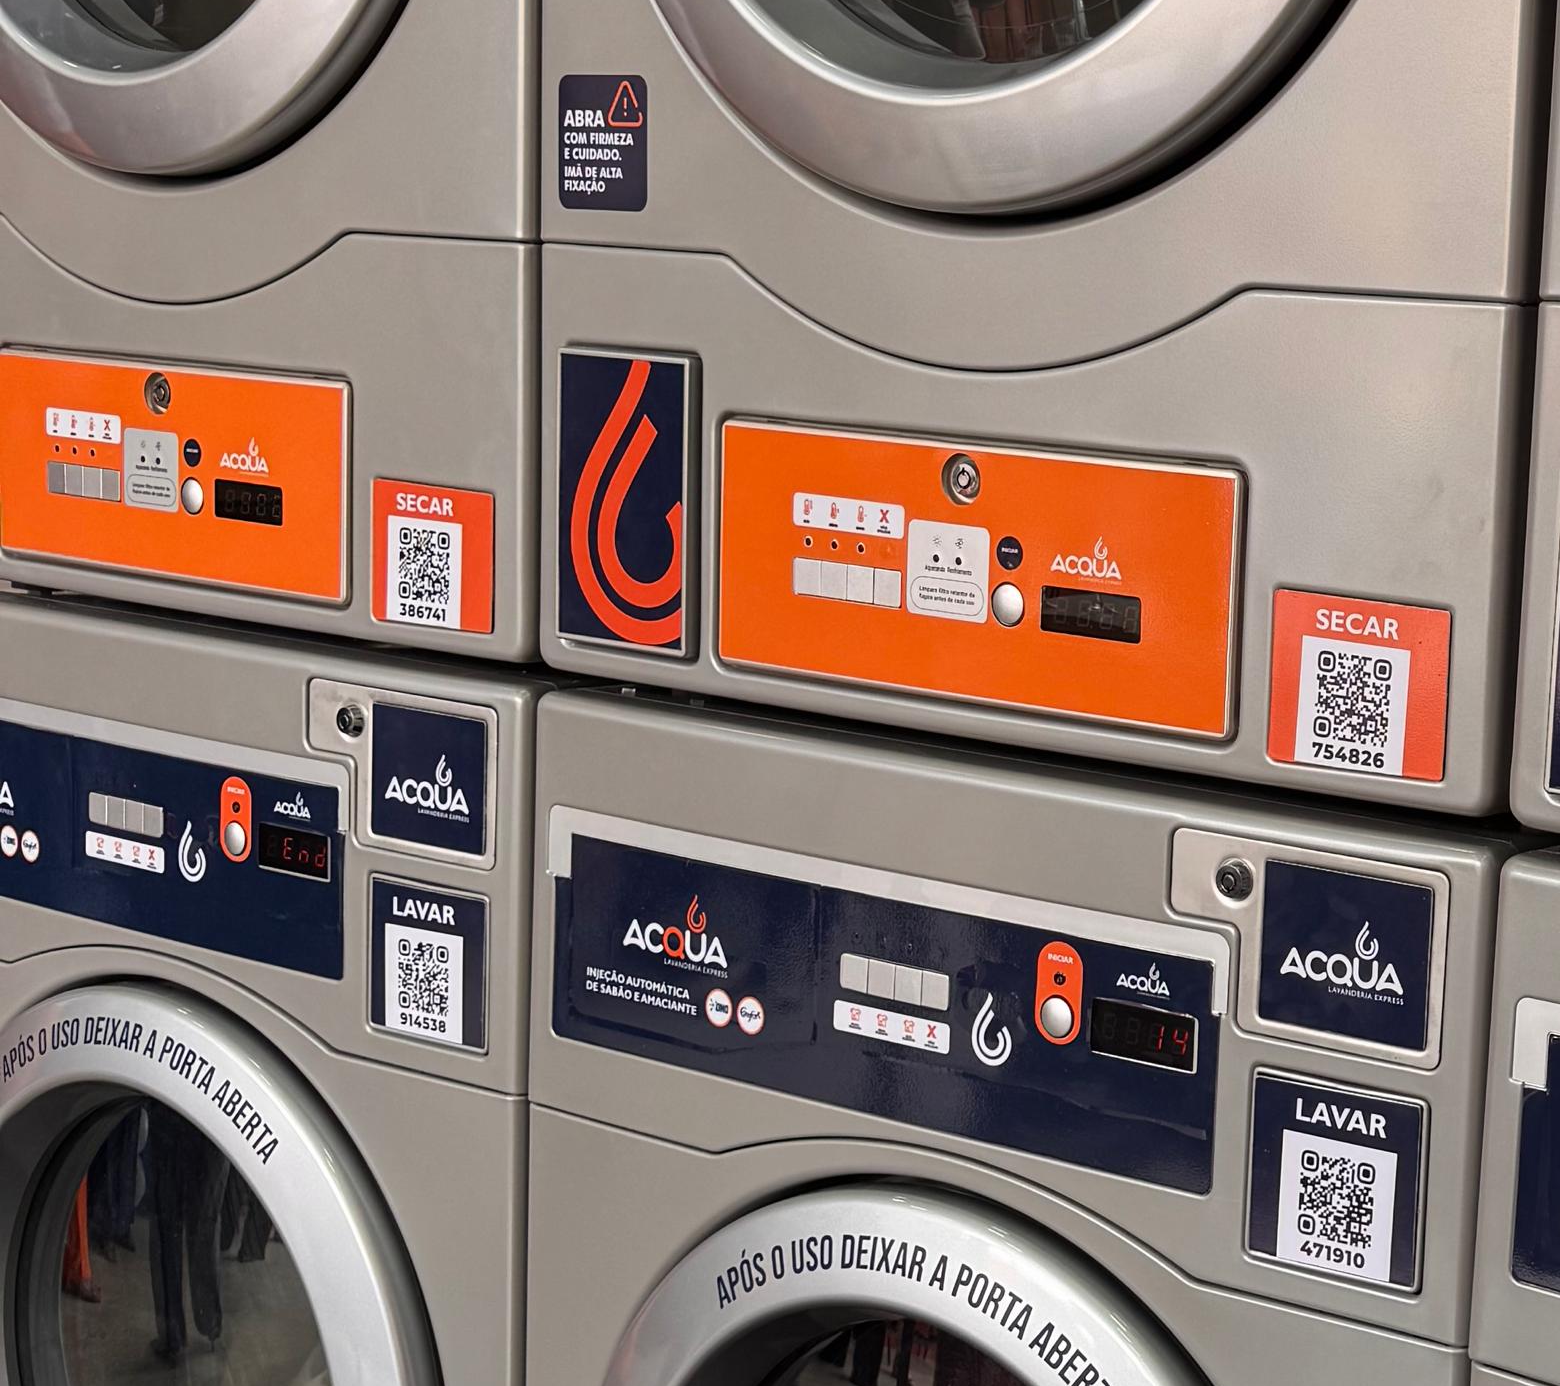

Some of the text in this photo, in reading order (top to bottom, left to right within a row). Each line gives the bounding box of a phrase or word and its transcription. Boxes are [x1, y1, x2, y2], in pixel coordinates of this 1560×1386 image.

[564, 110, 605, 127] ABRA
[564, 132, 633, 146] COM FIRMEZA
[564, 148, 622, 161] E CUIDADO.
[585, 166, 597, 178] DE
[600, 167, 623, 179] ALTA
[564, 178, 605, 194] FIXAÇÃO
[220, 452, 269, 473] ACQUA
[396, 492, 454, 517] SECAR
[1050, 554, 1122, 580] ACQUA
[400, 603, 446, 622] 386741
[1315, 608, 1399, 640] SECAR
[1312, 742, 1385, 768] 754826
[385, 775, 469, 815] ACQUA
[274, 801, 311, 819] ACQUA
[393, 896, 455, 926] LAVAR
[623, 918, 728, 969] ACQUA
[586, 966, 690, 1000] INJEÇÃO AUTOMÁTICA
[1116, 973, 1170, 996] ACQUA
[1279, 947, 1403, 996] ACQUA
[586, 980, 697, 1016] DE SABÃO E AMACIANTE
[1328, 985, 1404, 1006] LAVANDERIA EXPRESS
[400, 1012, 447, 1034] 914538
[1155, 1024, 1189, 1055] 14
[2, 1016, 279, 1164] APÓS O USO DEIXAR A PORTA ABERTA
[1295, 1097, 1387, 1139] LAVAR
[1300, 1240, 1365, 1269] 471910
[716, 1249, 767, 1309] APÓS
[772, 1245, 784, 1279] O
[791, 1235, 833, 1272] USO
[841, 1234, 927, 1282] DEIXAR
[928, 1254, 949, 1292] A
[951, 1263, 1034, 1340] PORTA
